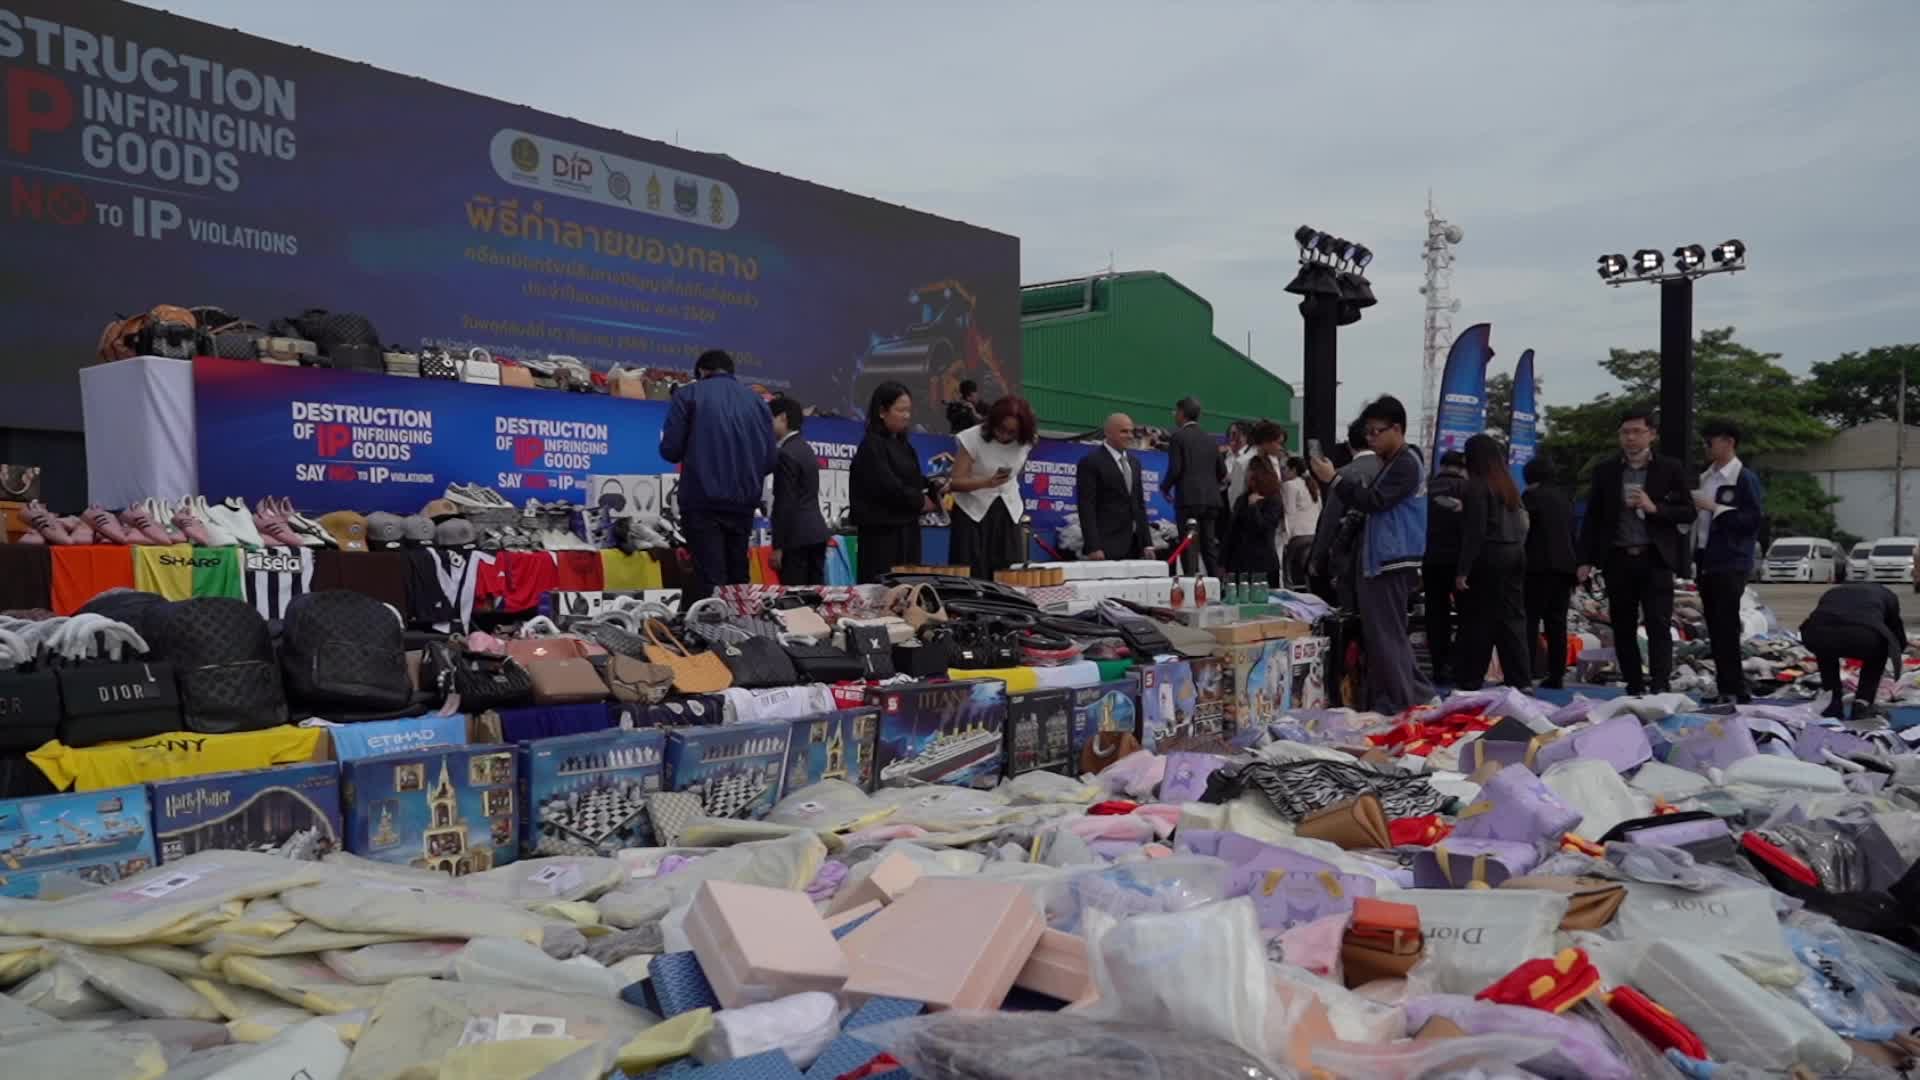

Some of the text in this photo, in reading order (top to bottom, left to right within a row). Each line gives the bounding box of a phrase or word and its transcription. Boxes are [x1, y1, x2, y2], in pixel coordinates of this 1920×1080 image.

[83, 84, 296, 160] INFRINGING
[82, 125, 240, 192] GOODS
[95, 203, 122, 227] TO
[133, 197, 182, 240] IP
[187, 218, 297, 255] VIOLATIONS
[292, 401, 432, 428] DESTRUCTION
[495, 416, 608, 440] DESTRUCTION
[293, 423, 432, 457] OF IP INFRINGING
[496, 435, 513, 451] OF
[544, 439, 608, 455] INFRINGING
[352, 442, 411, 461] GOODS
[544, 453, 591, 469] GOODS
[296, 464, 326, 482] SAY
[370, 467, 389, 483] IP
[498, 472, 522, 488] SAY
[559, 475, 574, 490] IP
[160, 554, 221, 567] SHARP
[264, 554, 300, 571] sela
[98, 683, 144, 702] DIOR
[1424, 927, 1486, 945] Dior
